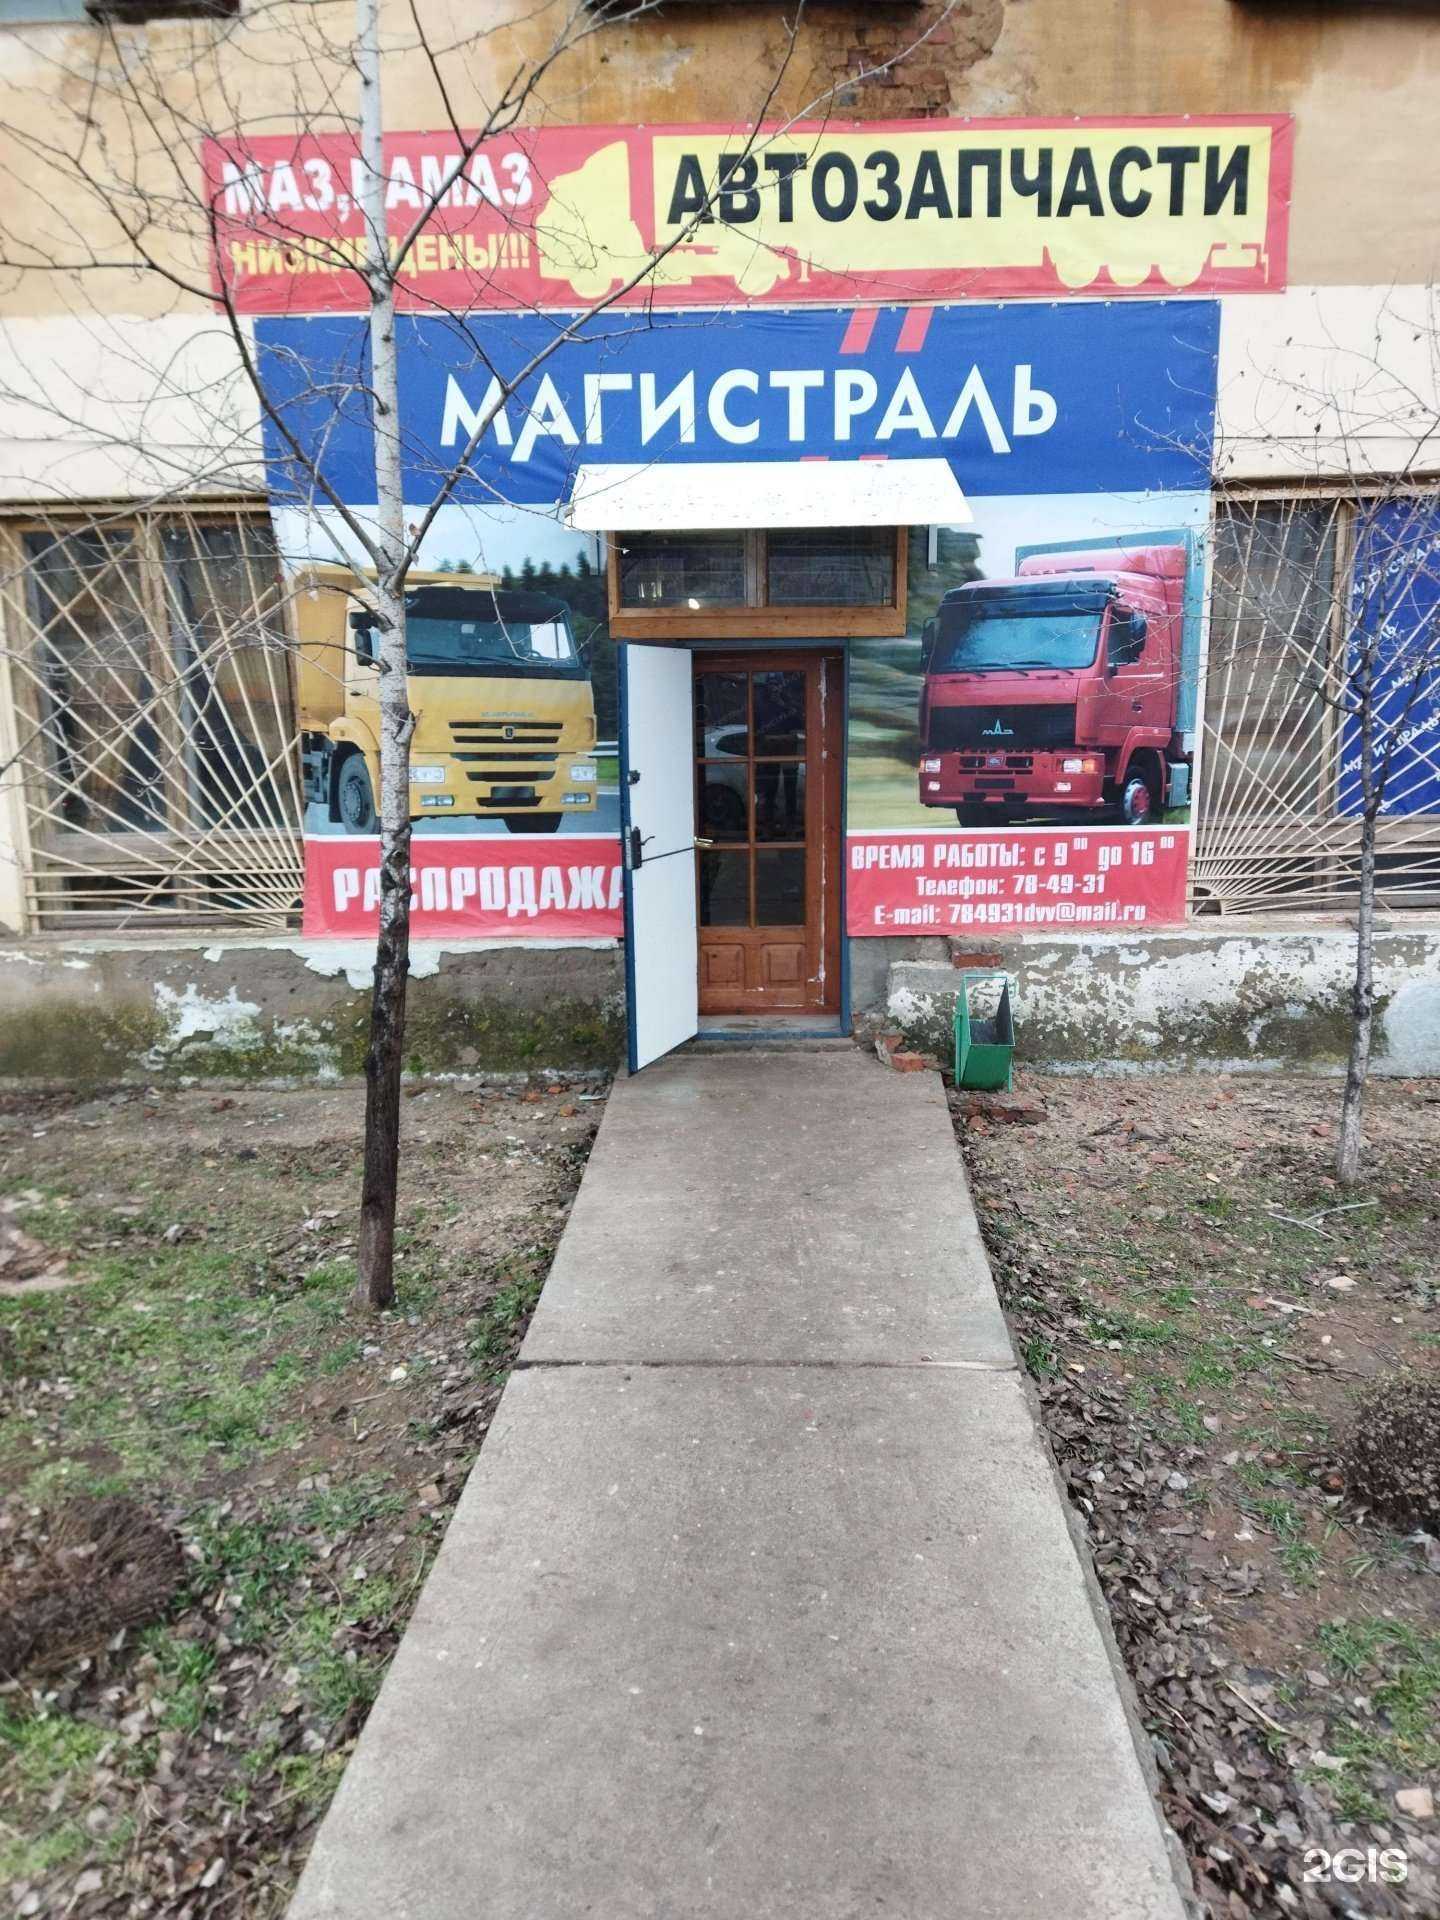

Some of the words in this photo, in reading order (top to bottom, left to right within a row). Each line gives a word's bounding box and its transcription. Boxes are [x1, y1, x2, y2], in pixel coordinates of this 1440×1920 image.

[666, 144, 1250, 225] АВТОЗАПЧАСТИ
[440, 364, 1057, 462] МАГИСТРАЛЬ
[851, 844, 925, 869] ВРЕМЯ
[932, 843, 1026, 868] РАБОТЫ:
[915, 876, 1005, 899] Телефон:
[1012, 873, 1106, 895] 78-49-31
[874, 903, 941, 925] E-mail:
[948, 901, 1147, 925] 784931dvv@mail.ru
